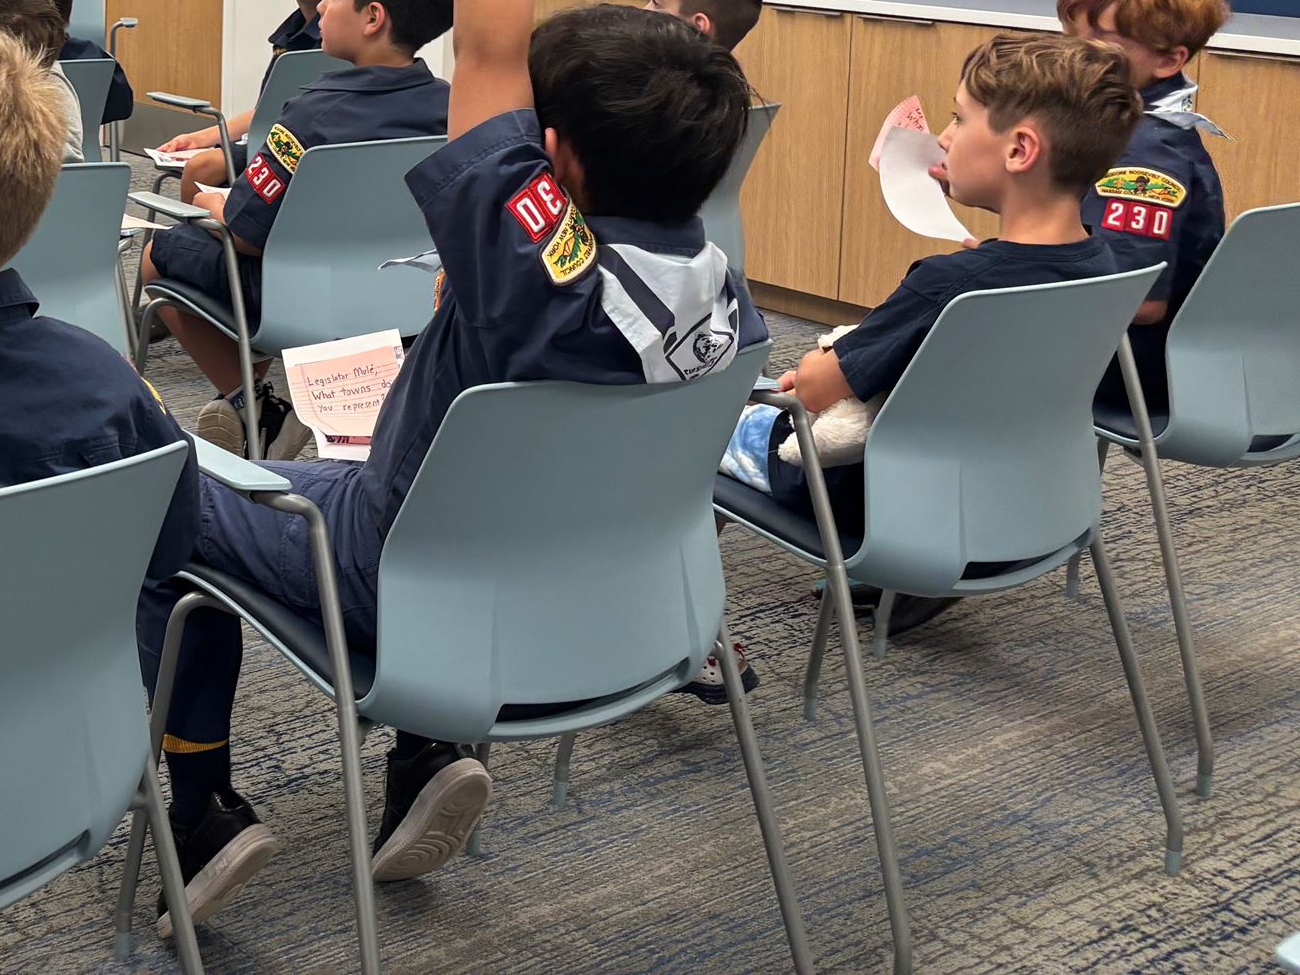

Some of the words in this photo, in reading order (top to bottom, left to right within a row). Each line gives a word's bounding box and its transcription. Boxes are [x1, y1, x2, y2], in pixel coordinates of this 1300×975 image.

[247, 156, 281, 198] 230
[1107, 203, 1168, 235] 230
[547, 242, 561, 258] YORK
[560, 257, 585, 276] COUNCIL
[306, 372, 349, 387] Legislator
[311, 390, 336, 401] What
[340, 385, 371, 396] towns
